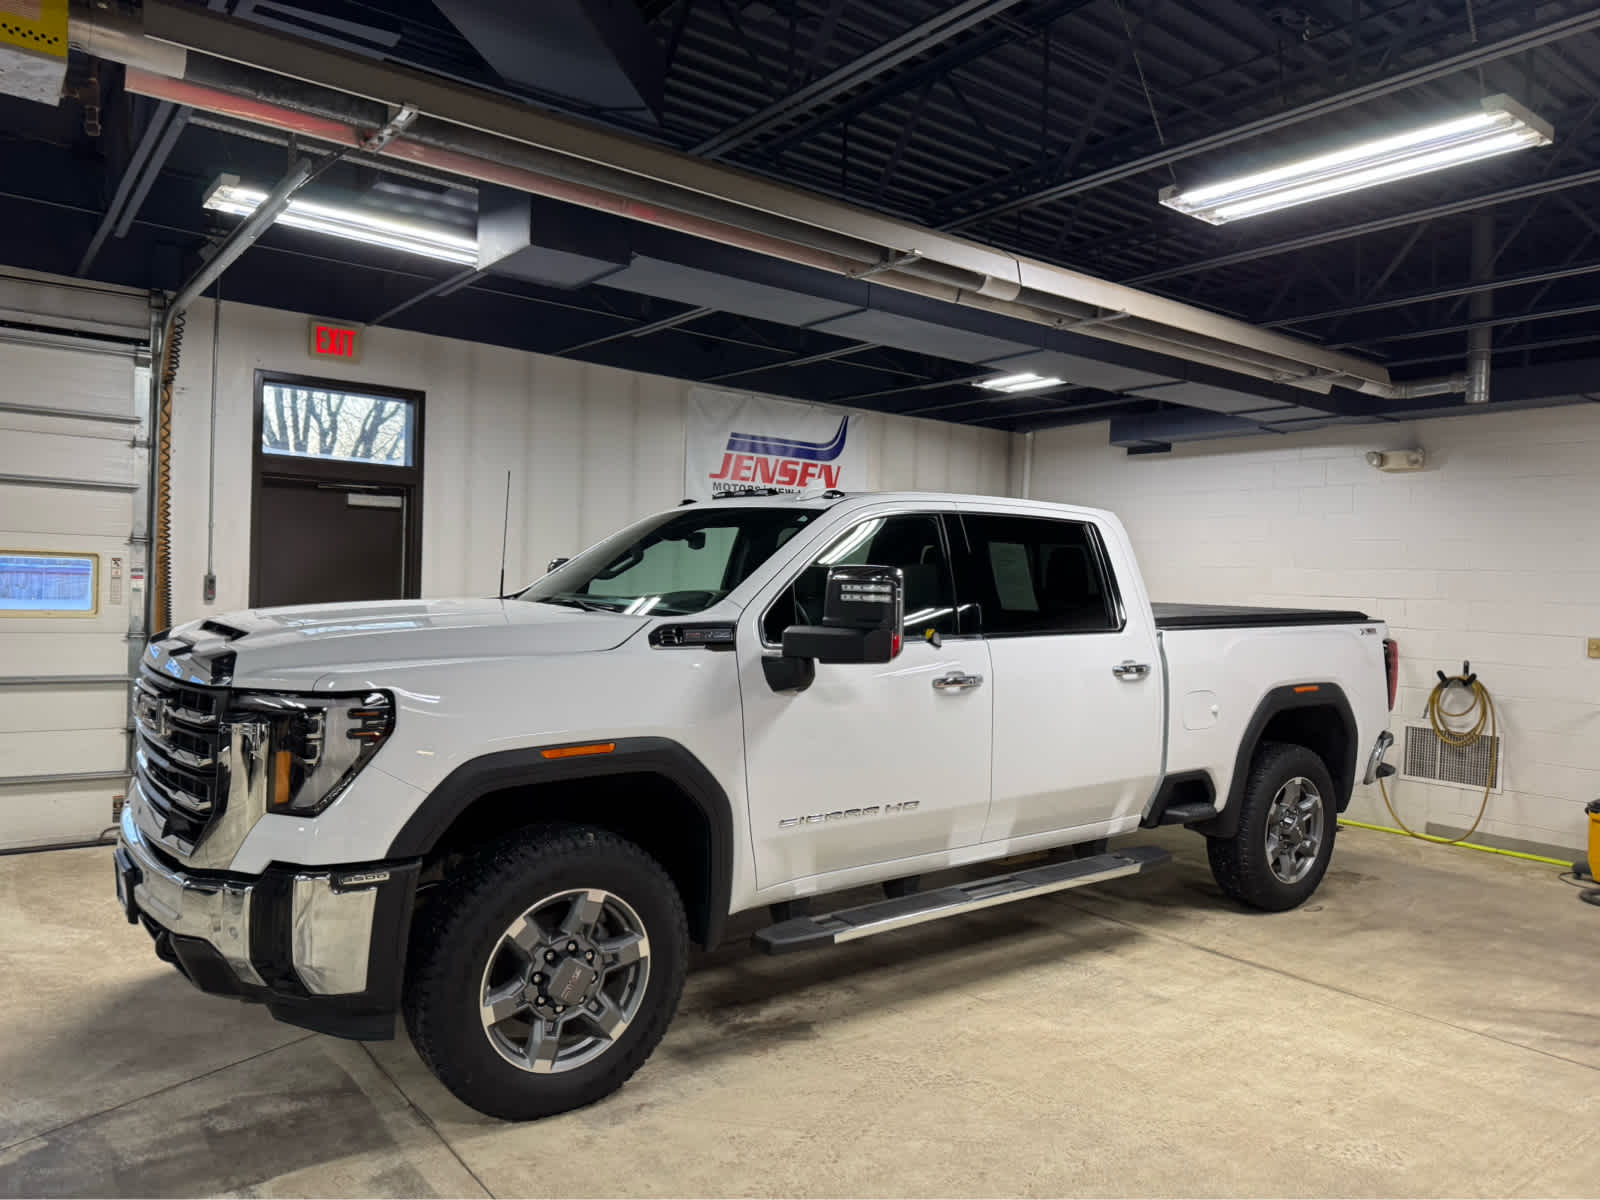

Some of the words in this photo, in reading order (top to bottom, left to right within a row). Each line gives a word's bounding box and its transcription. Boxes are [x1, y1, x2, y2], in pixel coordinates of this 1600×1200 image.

[316, 326, 356, 358] EXIT
[708, 453, 842, 489] JENSEN
[778, 805, 880, 829] SIERRA
